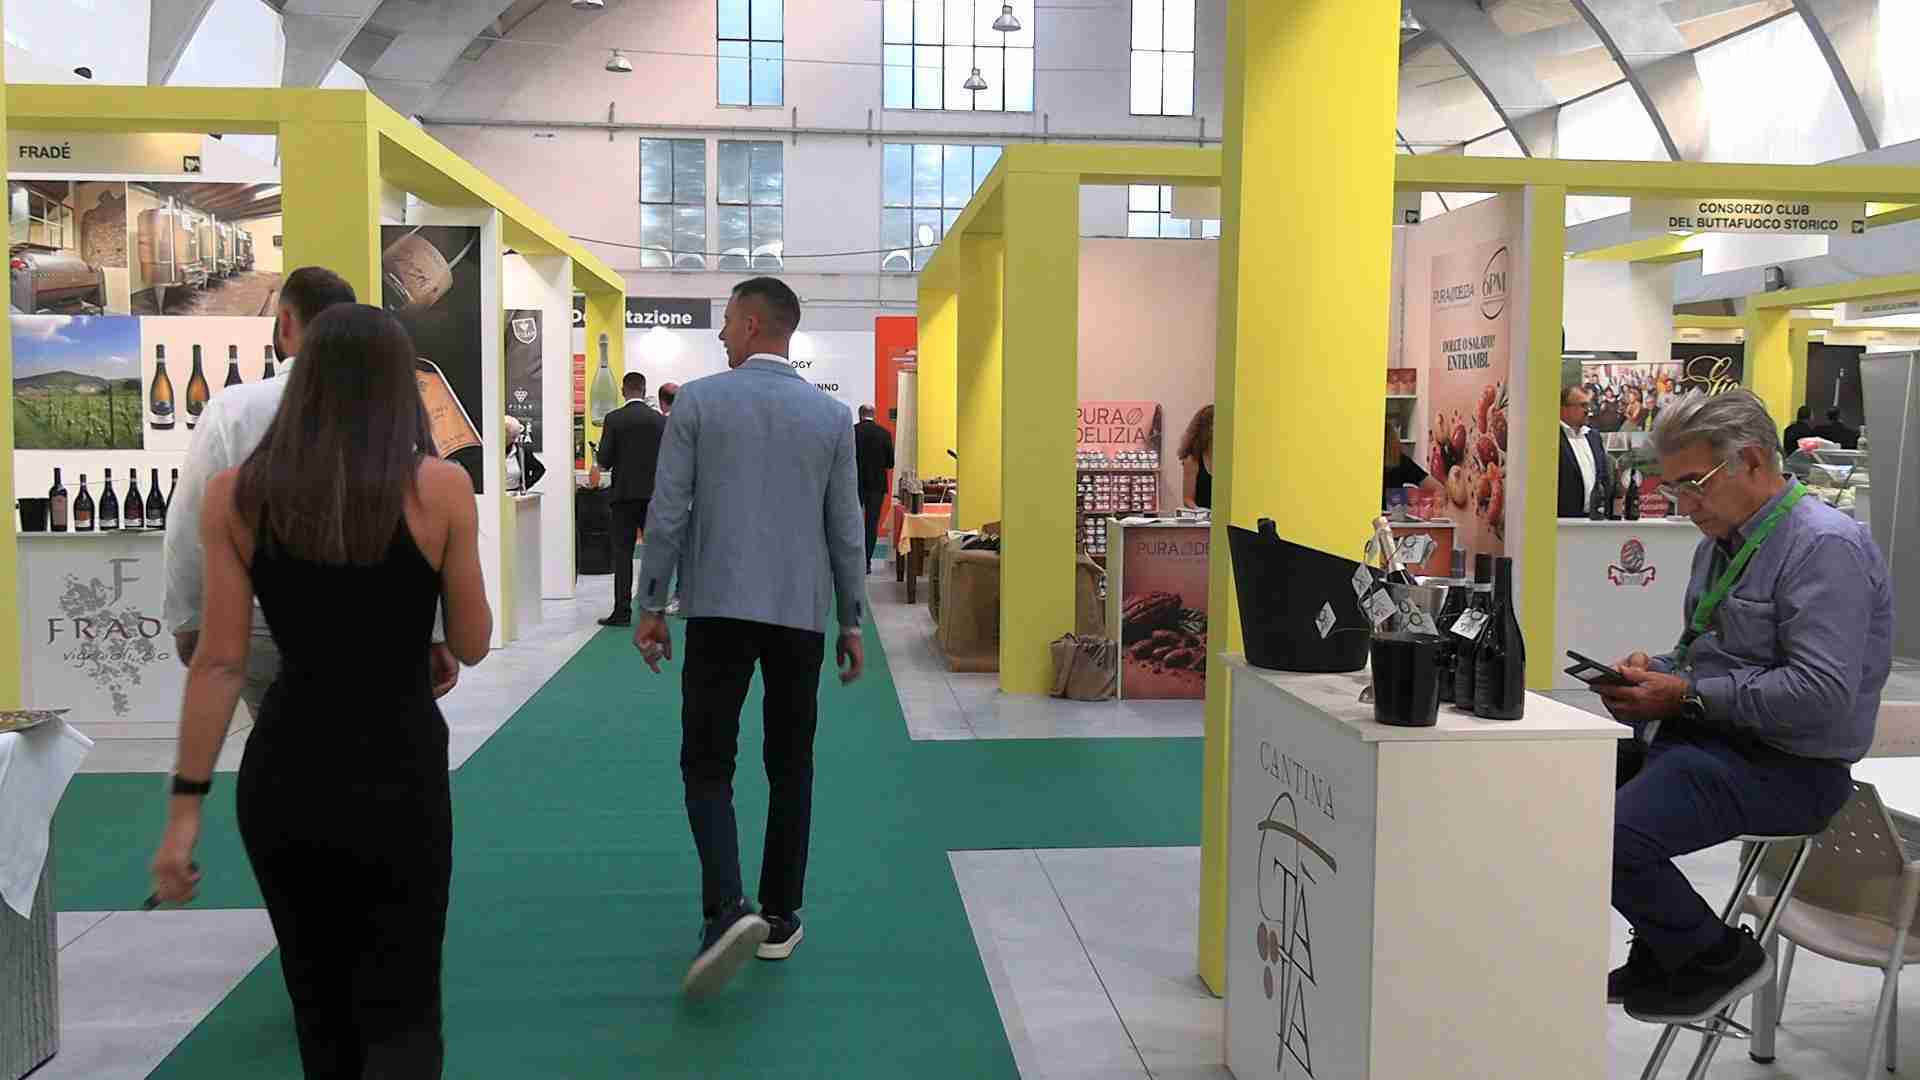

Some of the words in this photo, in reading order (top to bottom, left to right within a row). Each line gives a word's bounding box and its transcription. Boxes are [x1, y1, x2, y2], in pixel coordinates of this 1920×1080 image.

[18, 141, 72, 160] FRADÉ
[1698, 202, 1773, 216] CONSORZIO
[1775, 204, 1811, 217] CLUB
[1668, 216, 1693, 228] DEL
[1696, 217, 1781, 230] BUTTAFUOCO
[1784, 218, 1839, 231] STORICO
[1259, 740, 1336, 822] CANTINA
